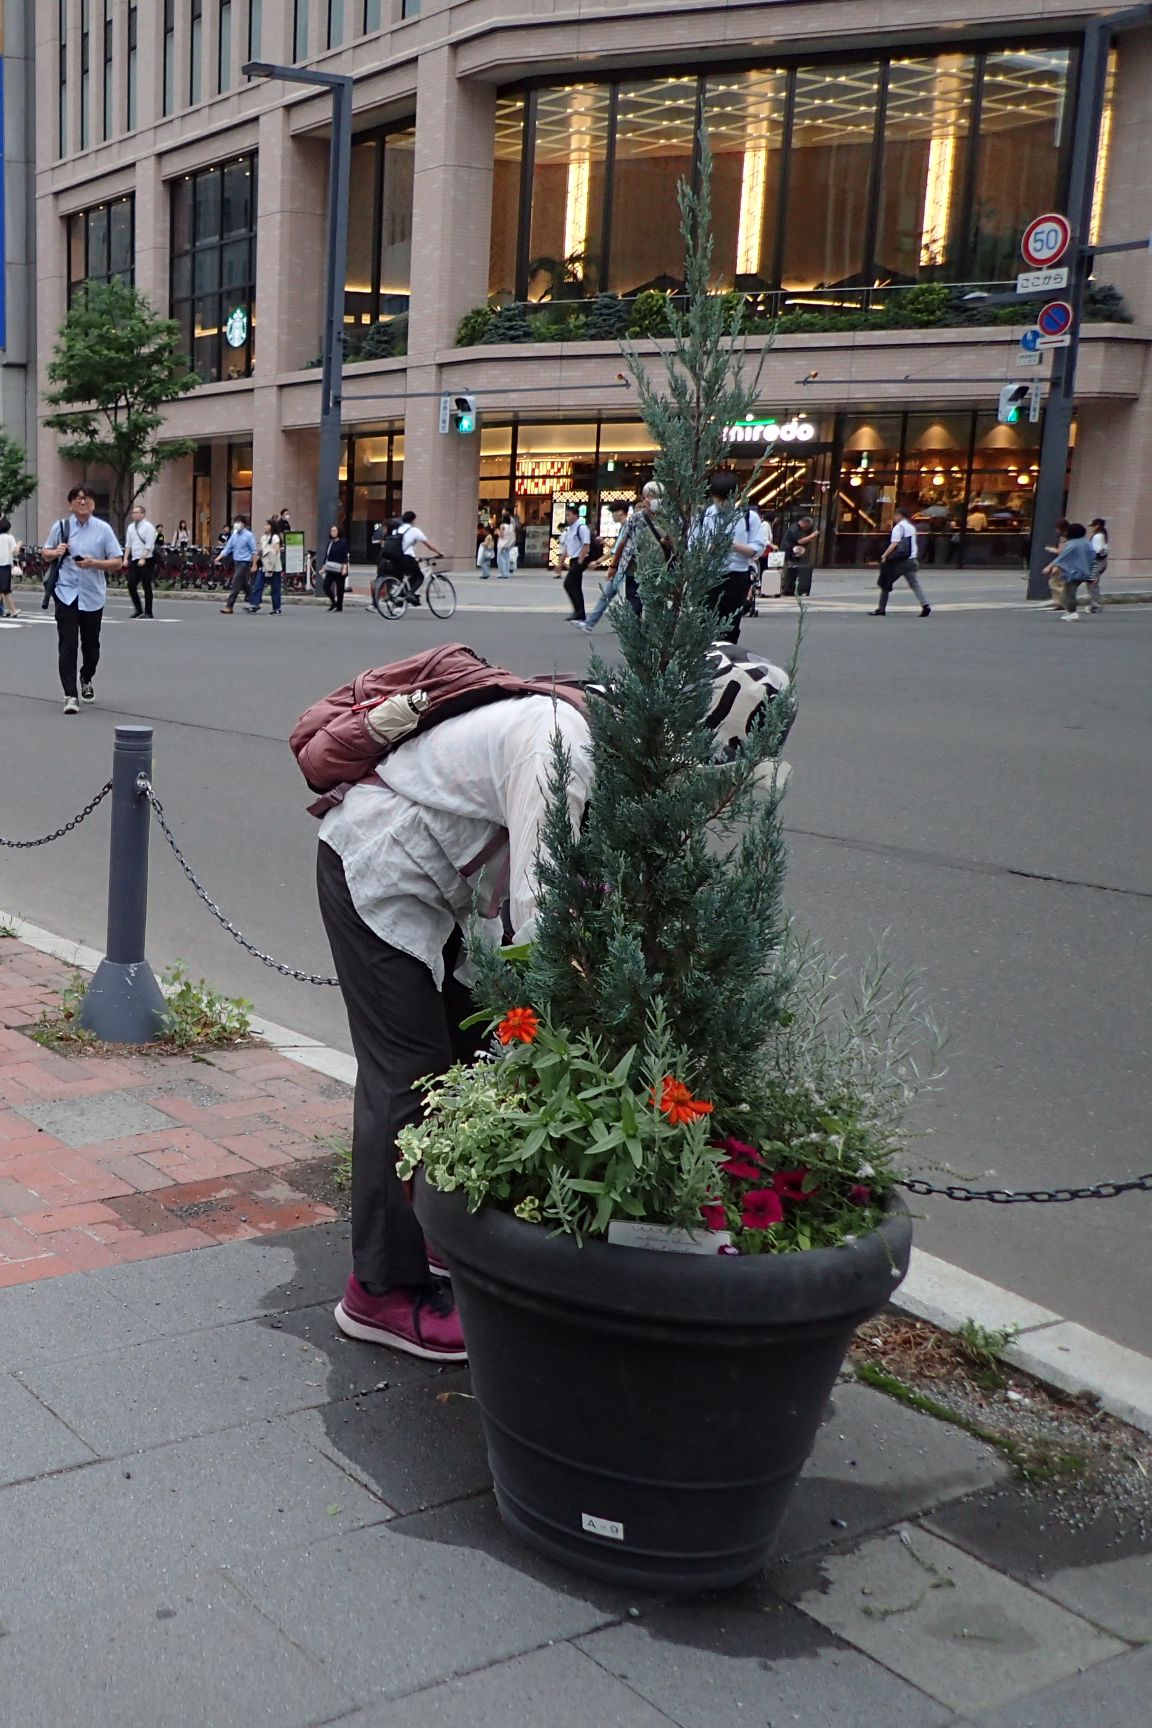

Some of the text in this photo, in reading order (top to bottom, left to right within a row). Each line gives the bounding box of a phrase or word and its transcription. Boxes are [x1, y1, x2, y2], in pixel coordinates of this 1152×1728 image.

[1033, 229, 1058, 252] 50
[1020, 273, 1063, 288] ここから
